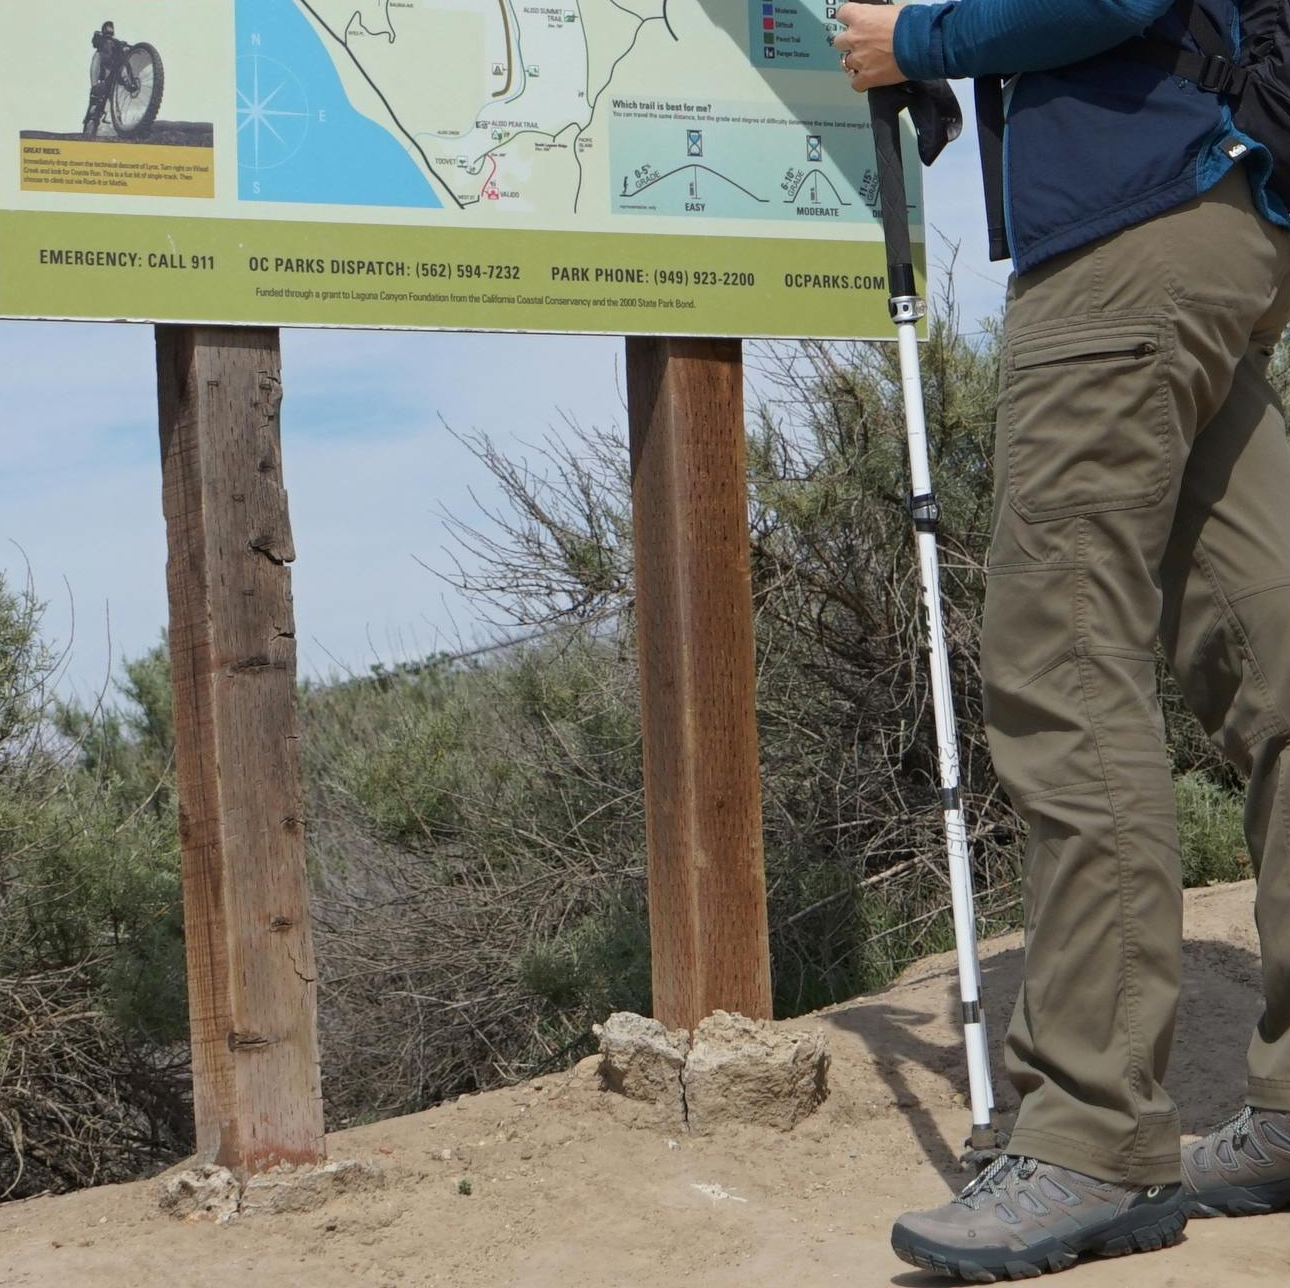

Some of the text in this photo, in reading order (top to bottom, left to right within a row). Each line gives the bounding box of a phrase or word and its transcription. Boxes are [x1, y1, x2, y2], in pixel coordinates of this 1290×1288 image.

[251, 33, 261, 46] N
[319, 110, 325, 122] E
[612, 99, 711, 116] Which trail is best for me?
[253, 181, 260, 194] S
[635, 170, 661, 188] GRADE
[788, 169, 804, 197] GRADE
[500, 191, 519, 199] VALIDO
[685, 202, 706, 212] EASY
[797, 207, 839, 216] MODERATE
[40, 249, 213, 269] EMERGENCY: CALL 911
[249, 256, 519, 279] OC PARKS DISPATCH: (562) 594-7232
[551, 267, 754, 286] PARK PHONE: (949) 923-2200
[785, 273, 885, 290] OCPARKS.COM
[255, 287, 283, 297] Funded
[284, 288, 313, 300] through
[321, 291, 341, 300] grant
[342, 291, 349, 299] to
[351, 290, 378, 301] Laguna
[379, 291, 407, 302] Canyon
[409, 291, 449, 302] Foundation
[450, 293, 467, 302] from
[468, 293, 480, 303] the
[481, 293, 515, 303] California
[517, 294, 543, 304] Coastal
[545, 295, 591, 307] Conservancy
[592, 297, 605, 306] and
[606, 298, 618, 306] the
[619, 298, 636, 307] 2000
[637, 298, 656, 308] State
[658, 298, 673, 307] Park
[675, 298, 695, 308] Bond.
